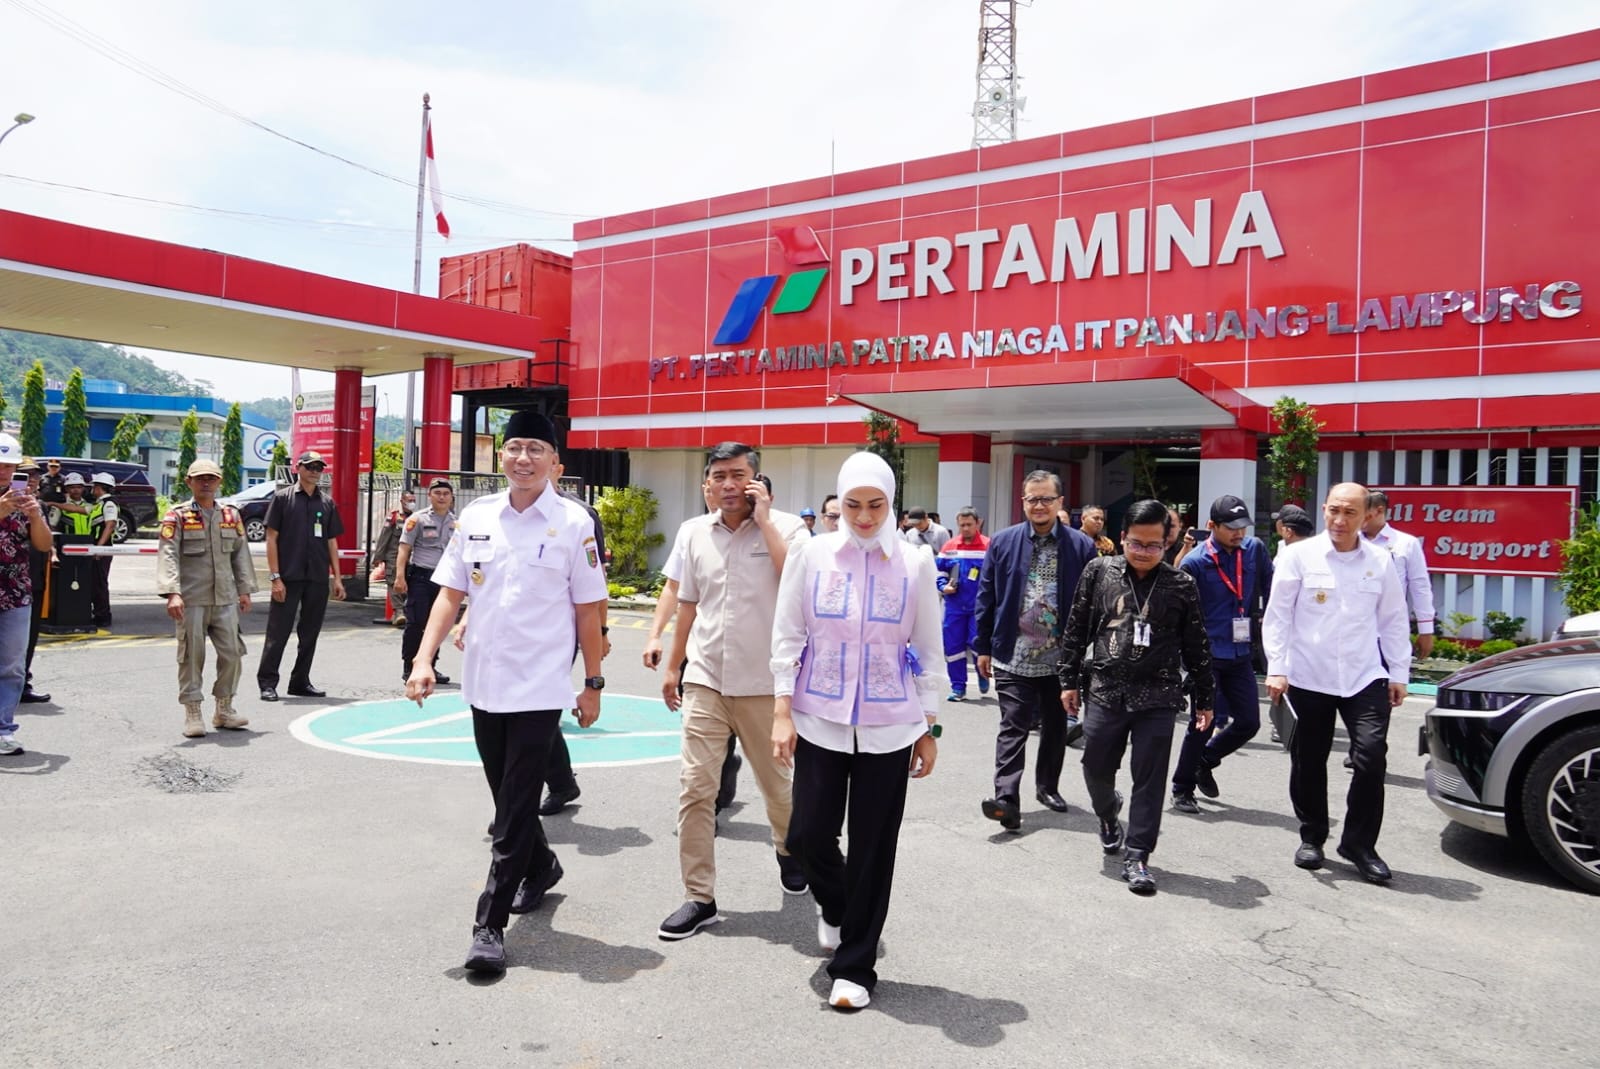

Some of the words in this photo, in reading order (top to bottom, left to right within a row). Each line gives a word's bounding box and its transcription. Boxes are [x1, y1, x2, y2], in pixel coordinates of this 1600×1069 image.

[839, 190, 1284, 306] PERTAMINA
[650, 355, 686, 382] PT.
[690, 341, 848, 378] PERTAMINA
[852, 332, 956, 365] PATRA
[961, 324, 1069, 359] NIAGA
[1075, 320, 1110, 351] IT
[1115, 280, 1582, 348] PANJANG-LAMPUNG
[1422, 503, 1496, 523] Team
[1434, 536, 1550, 561] Support
